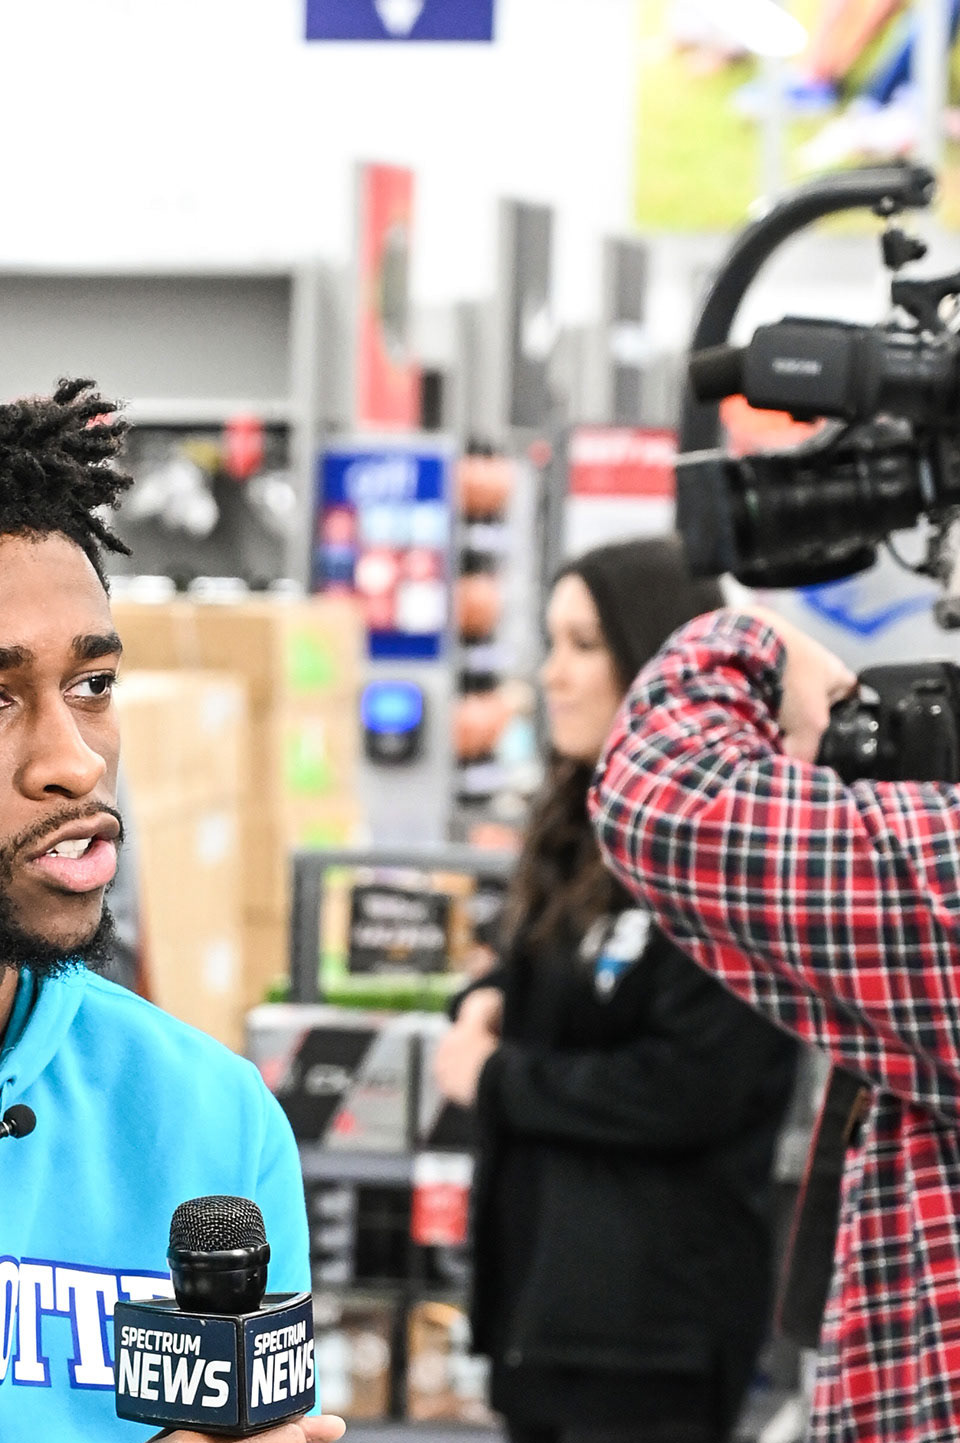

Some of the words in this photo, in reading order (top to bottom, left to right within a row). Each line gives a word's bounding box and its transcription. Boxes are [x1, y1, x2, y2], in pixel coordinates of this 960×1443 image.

[121, 1325, 201, 1356] SPECTRUM
[253, 1320, 306, 1356] SPECTRUM
[118, 1348, 232, 1408] NEWS
[251, 1338, 315, 1408] NEWS
